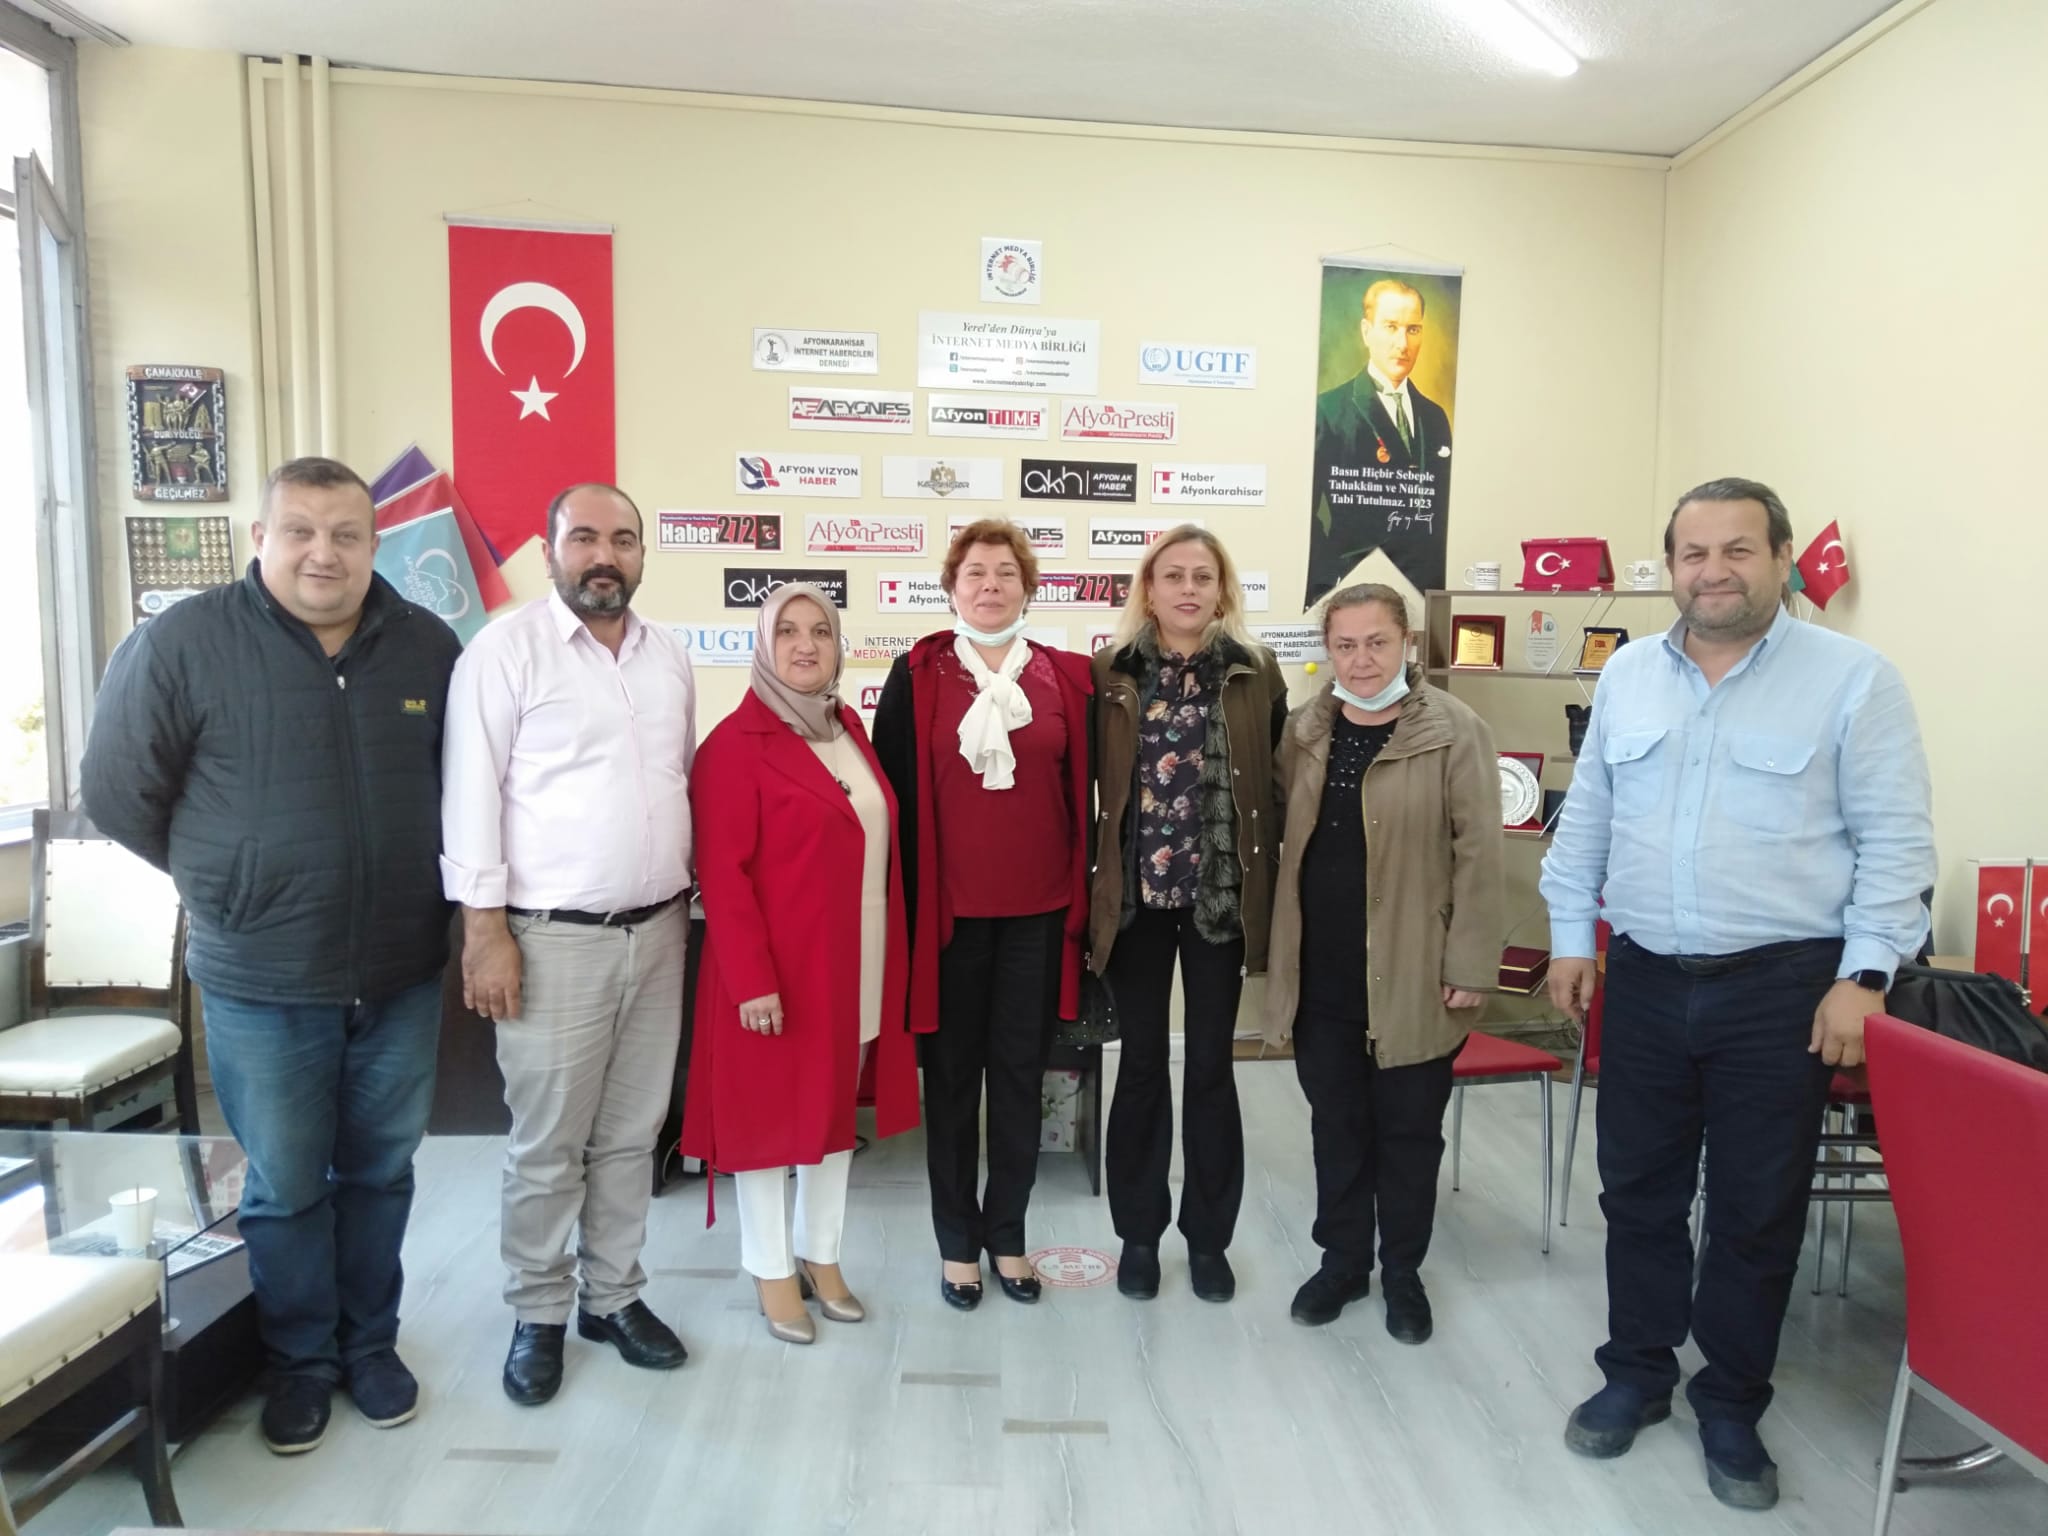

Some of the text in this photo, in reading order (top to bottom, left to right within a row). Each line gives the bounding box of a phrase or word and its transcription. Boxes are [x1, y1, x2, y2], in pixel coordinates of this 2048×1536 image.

[996, 338, 1038, 351] MEDYA
[1176, 350, 1250, 373] UGTF
[934, 408, 1040, 426] Afyon TIME
[779, 464, 815, 474] AFYON
[1331, 466, 1435, 483] Basın Hiçbir Sebeple
[799, 476, 837, 486] HABER
[1093, 473, 1133, 482] AFYON AK
[1181, 471, 1216, 482] Haber
[1098, 482, 1127, 491] HABER
[1180, 485, 1264, 497] Afyonkarahisar
[1329, 480, 1435, 495] Tahakküm ve Nüfuza
[1331, 494, 1432, 509] Tabi Tutulmaz. 1923
[1094, 530, 1142, 544] Afyon
[830, 581, 843, 589] AK
[1034, 583, 1077, 602] aber
[698, 630, 757, 651] UGT
